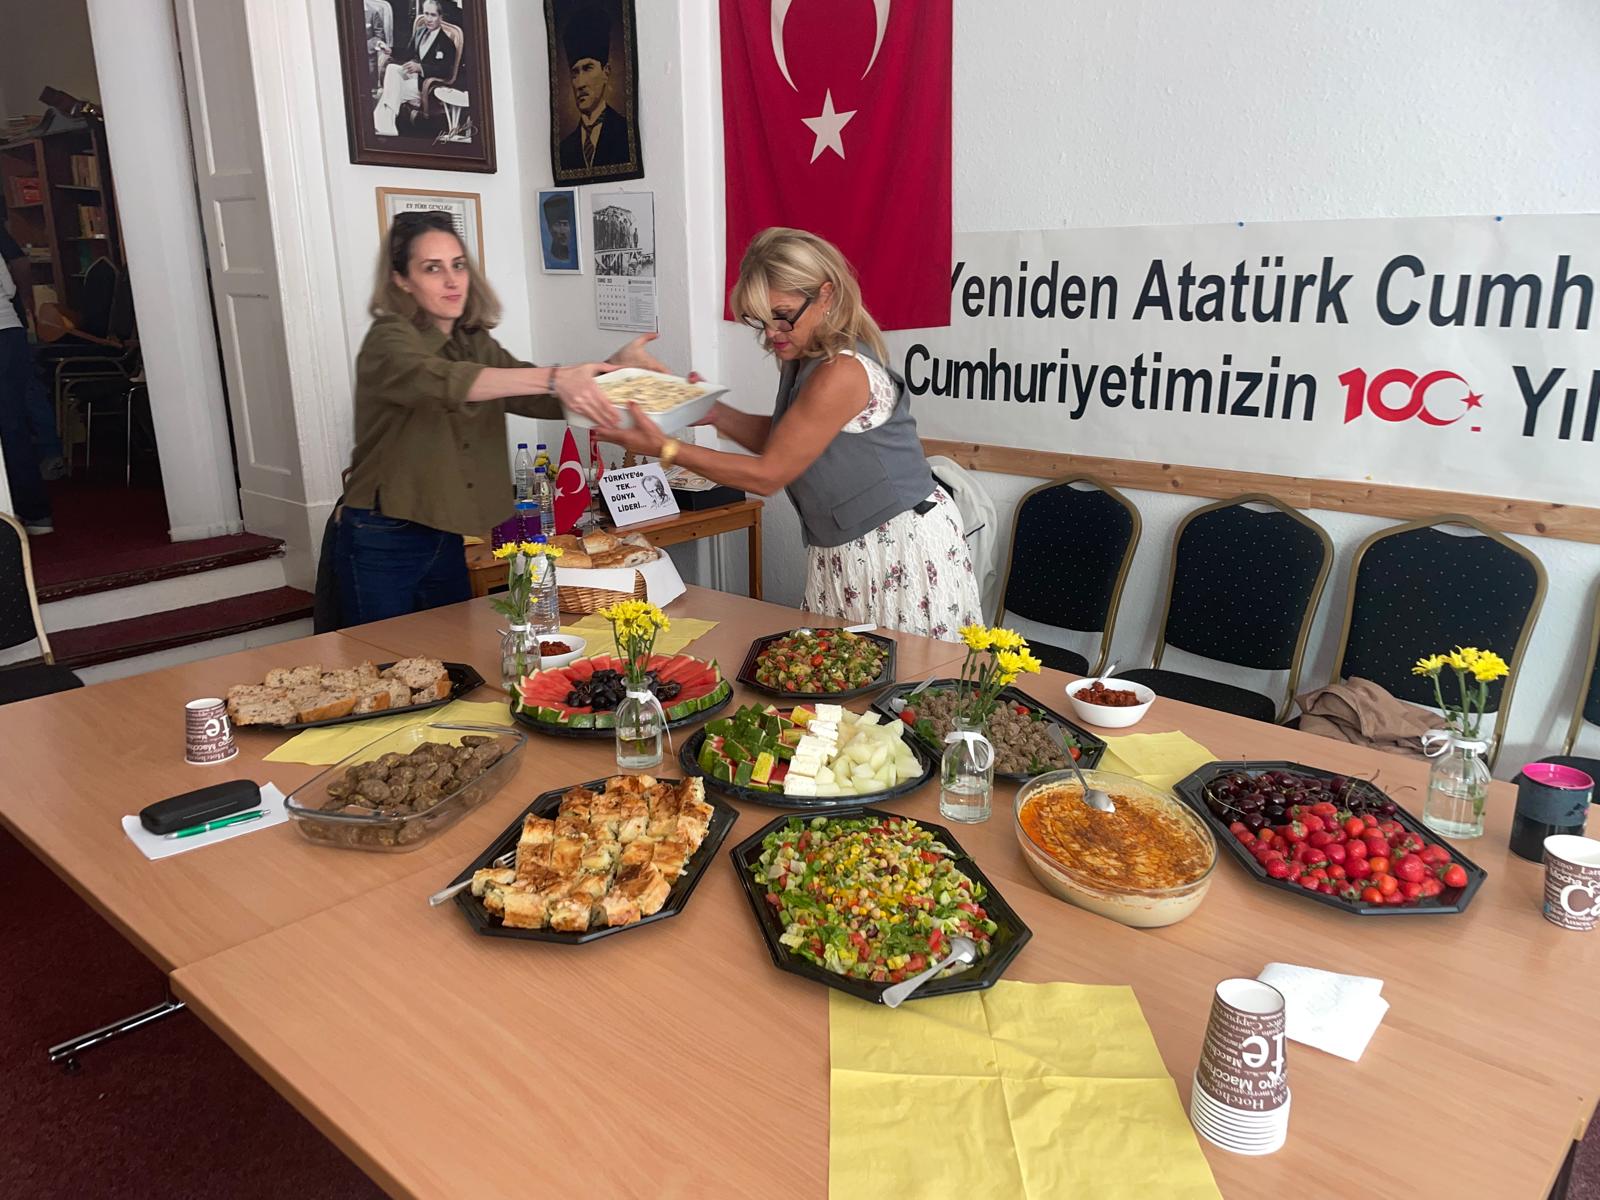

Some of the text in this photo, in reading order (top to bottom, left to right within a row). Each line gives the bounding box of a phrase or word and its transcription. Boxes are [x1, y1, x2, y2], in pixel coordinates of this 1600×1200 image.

[1132, 256, 1354, 324] Atatürk
[1376, 254, 1594, 330] Cumh
[904, 343, 1317, 422] Cumhuriyetimizin
[603, 471, 644, 483] TÜRKİYE'de
[611, 492, 636, 502] DÜNYA
